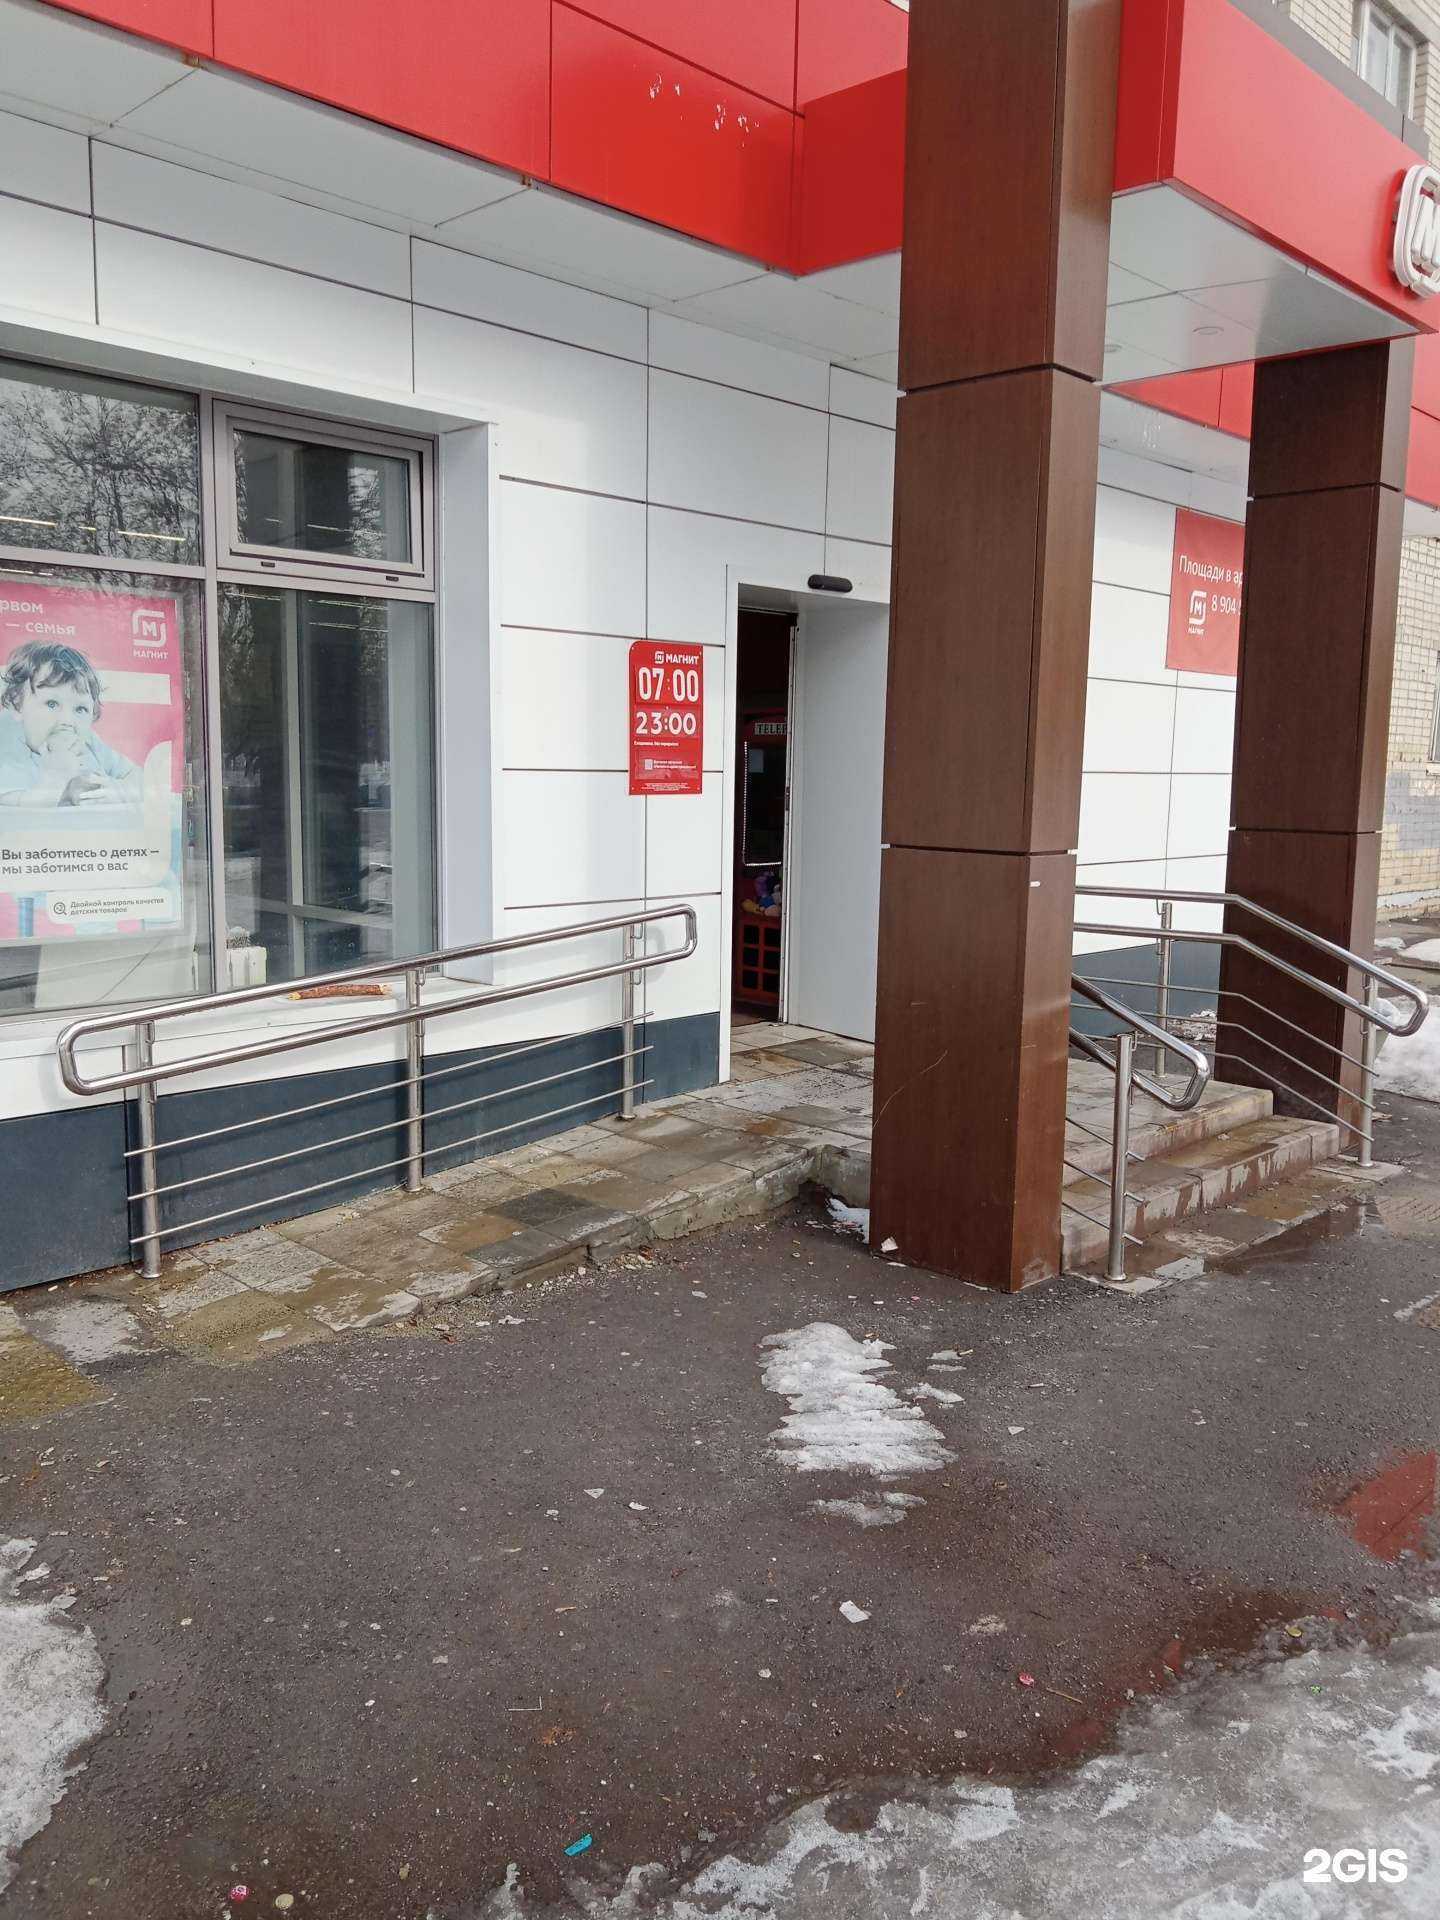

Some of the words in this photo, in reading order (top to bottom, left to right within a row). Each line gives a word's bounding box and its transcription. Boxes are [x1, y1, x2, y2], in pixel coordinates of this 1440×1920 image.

[1179, 555, 1225, 583] Площади
[1226, 569, 1232, 582] в
[1211, 594, 1218, 612] 8
[1220, 595, 1236, 616] 904
[25, 620, 76, 637] семья
[133, 648, 168, 660] МАГНИТ
[665, 653, 699, 665] МАГНИТ
[636, 711, 697, 735] 23:00
[2, 849, 22, 860] Вы
[25, 848, 97, 861] заботитесь
[99, 849, 107, 858] о
[110, 848, 147, 859] детях
[2, 865, 22, 875] мы
[25, 861, 94, 874] заботимся
[98, 863, 105, 872] о
[107, 862, 129, 872] вас
[70, 900, 102, 909] Двойной
[103, 899, 135, 908] контроль
